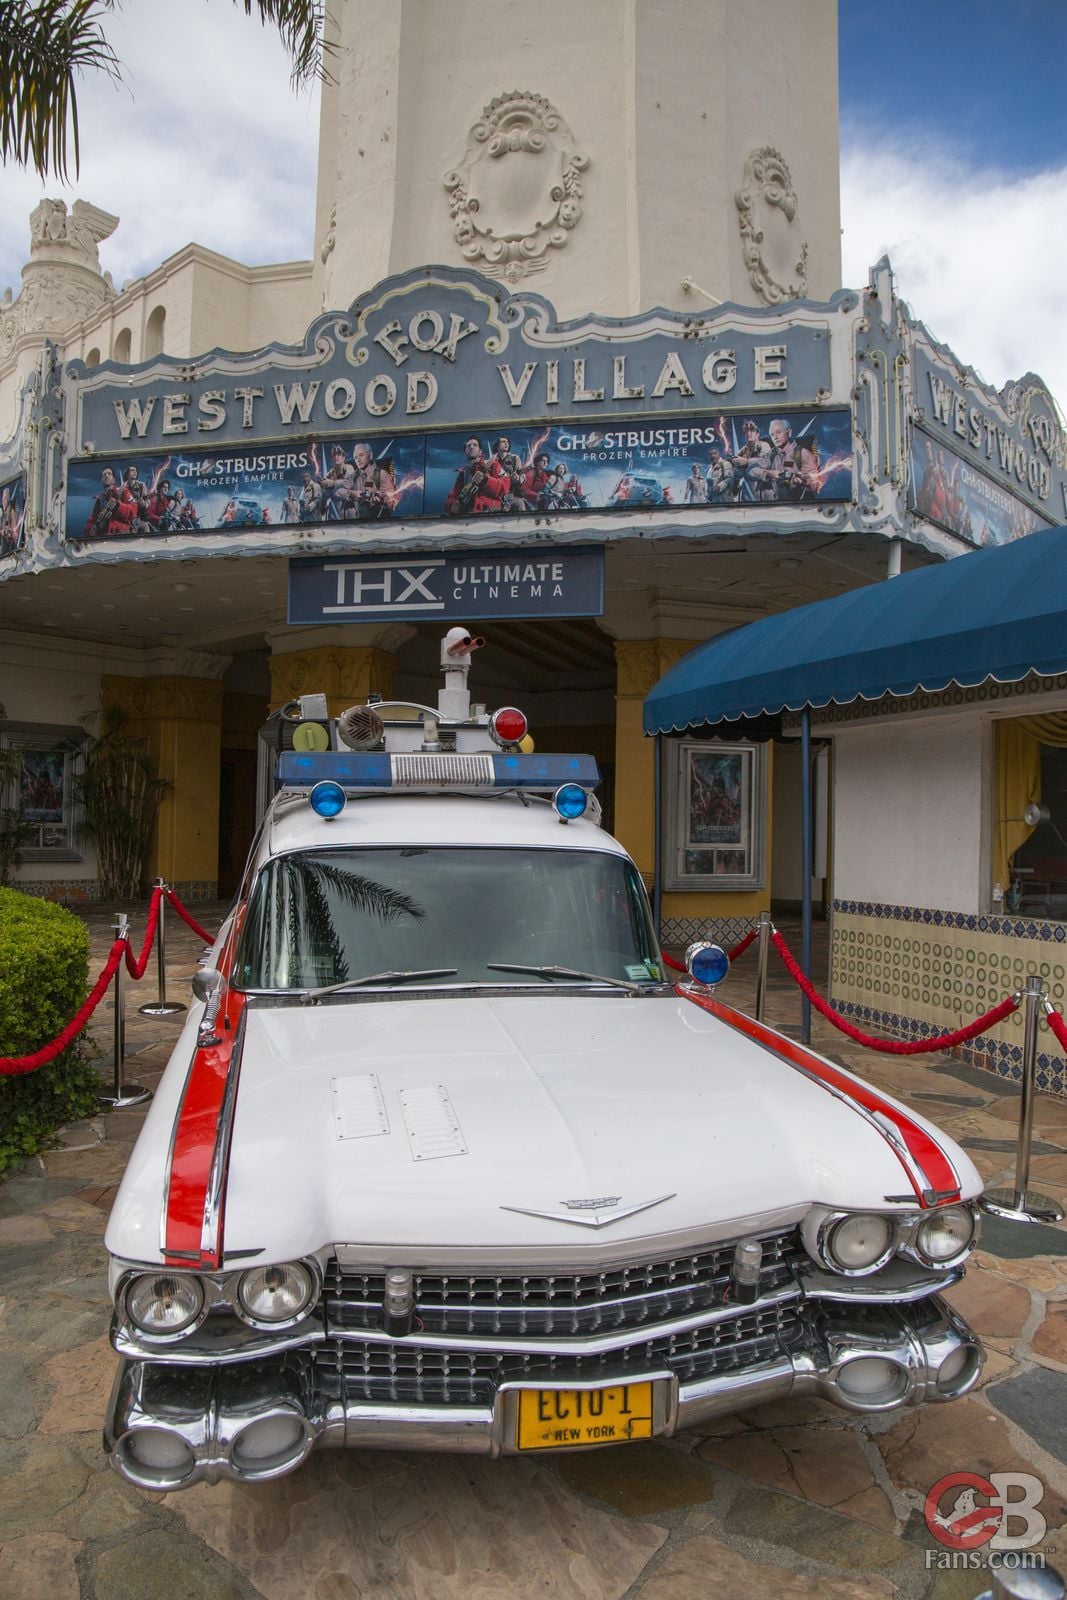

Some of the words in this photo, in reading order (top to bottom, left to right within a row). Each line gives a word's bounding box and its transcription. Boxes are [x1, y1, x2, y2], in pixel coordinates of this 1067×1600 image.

[373, 309, 479, 367] FOX
[113, 371, 438, 440] WESTWOOD
[497, 344, 787, 407] VILLAGE
[556, 427, 715, 451] GHOSTBUSTERS
[927, 371, 1053, 500] WESTWOOD
[176, 453, 308, 478] GHOSTBUSTERS
[583, 450, 632, 461] FROZEN
[640, 447, 688, 458] EMPIRE
[197, 475, 239, 487] FROZEN
[244, 472, 285, 483] EMPIRE
[453, 563, 564, 584] ULTIMATE
[323, 559, 446, 613] THX
[453, 584, 563, 600] CINEMA
[555, 1429, 581, 1441] NEW
[587, 1426, 616, 1438] YORK
